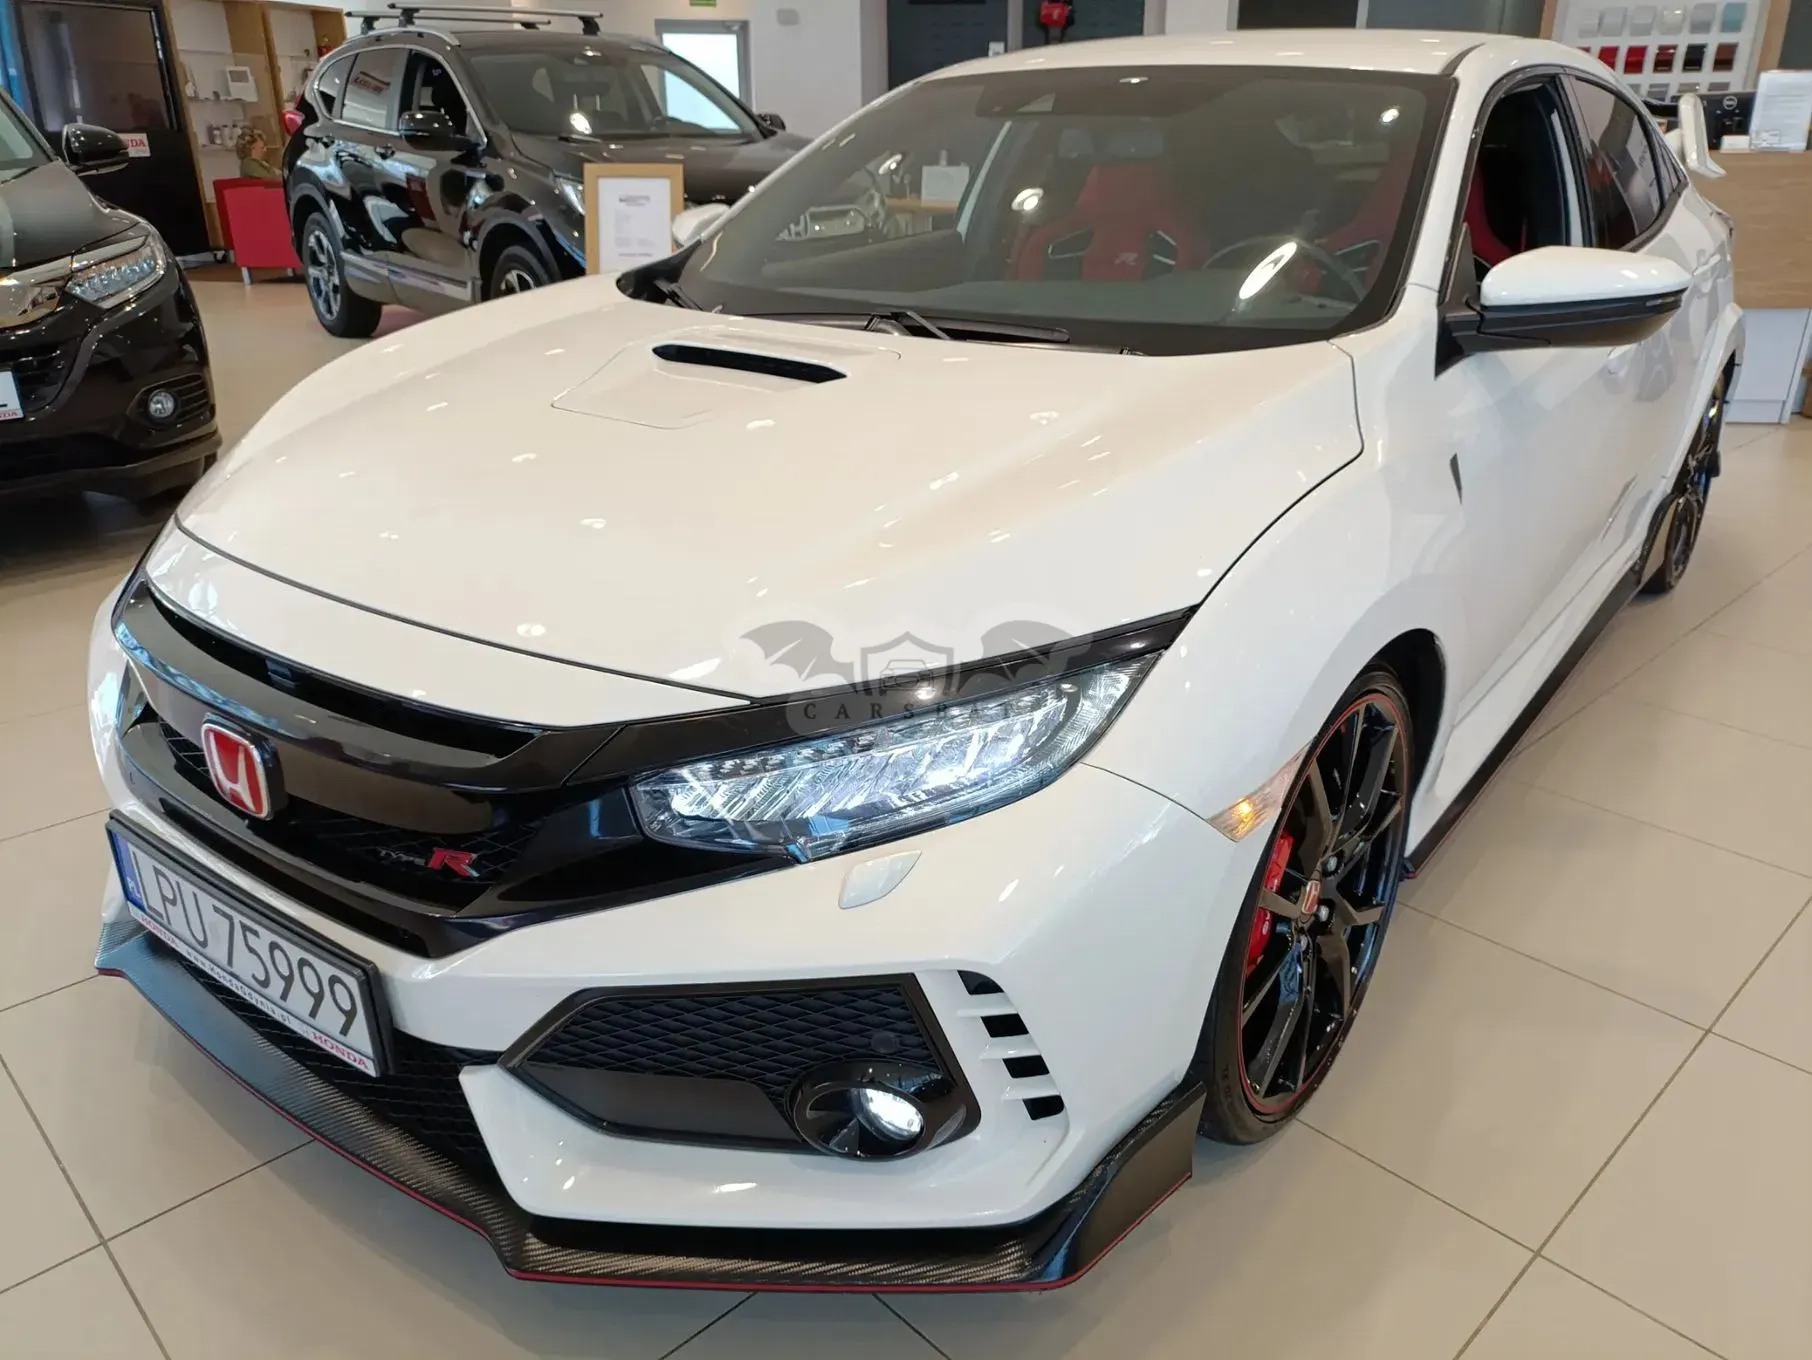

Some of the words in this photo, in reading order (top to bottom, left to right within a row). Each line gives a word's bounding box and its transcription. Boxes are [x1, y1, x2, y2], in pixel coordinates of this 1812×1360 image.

[427, 846, 480, 878] R
[132, 850, 209, 949] LPU
[212, 903, 358, 1037] 75999
[311, 1031, 369, 1070] HONDA
